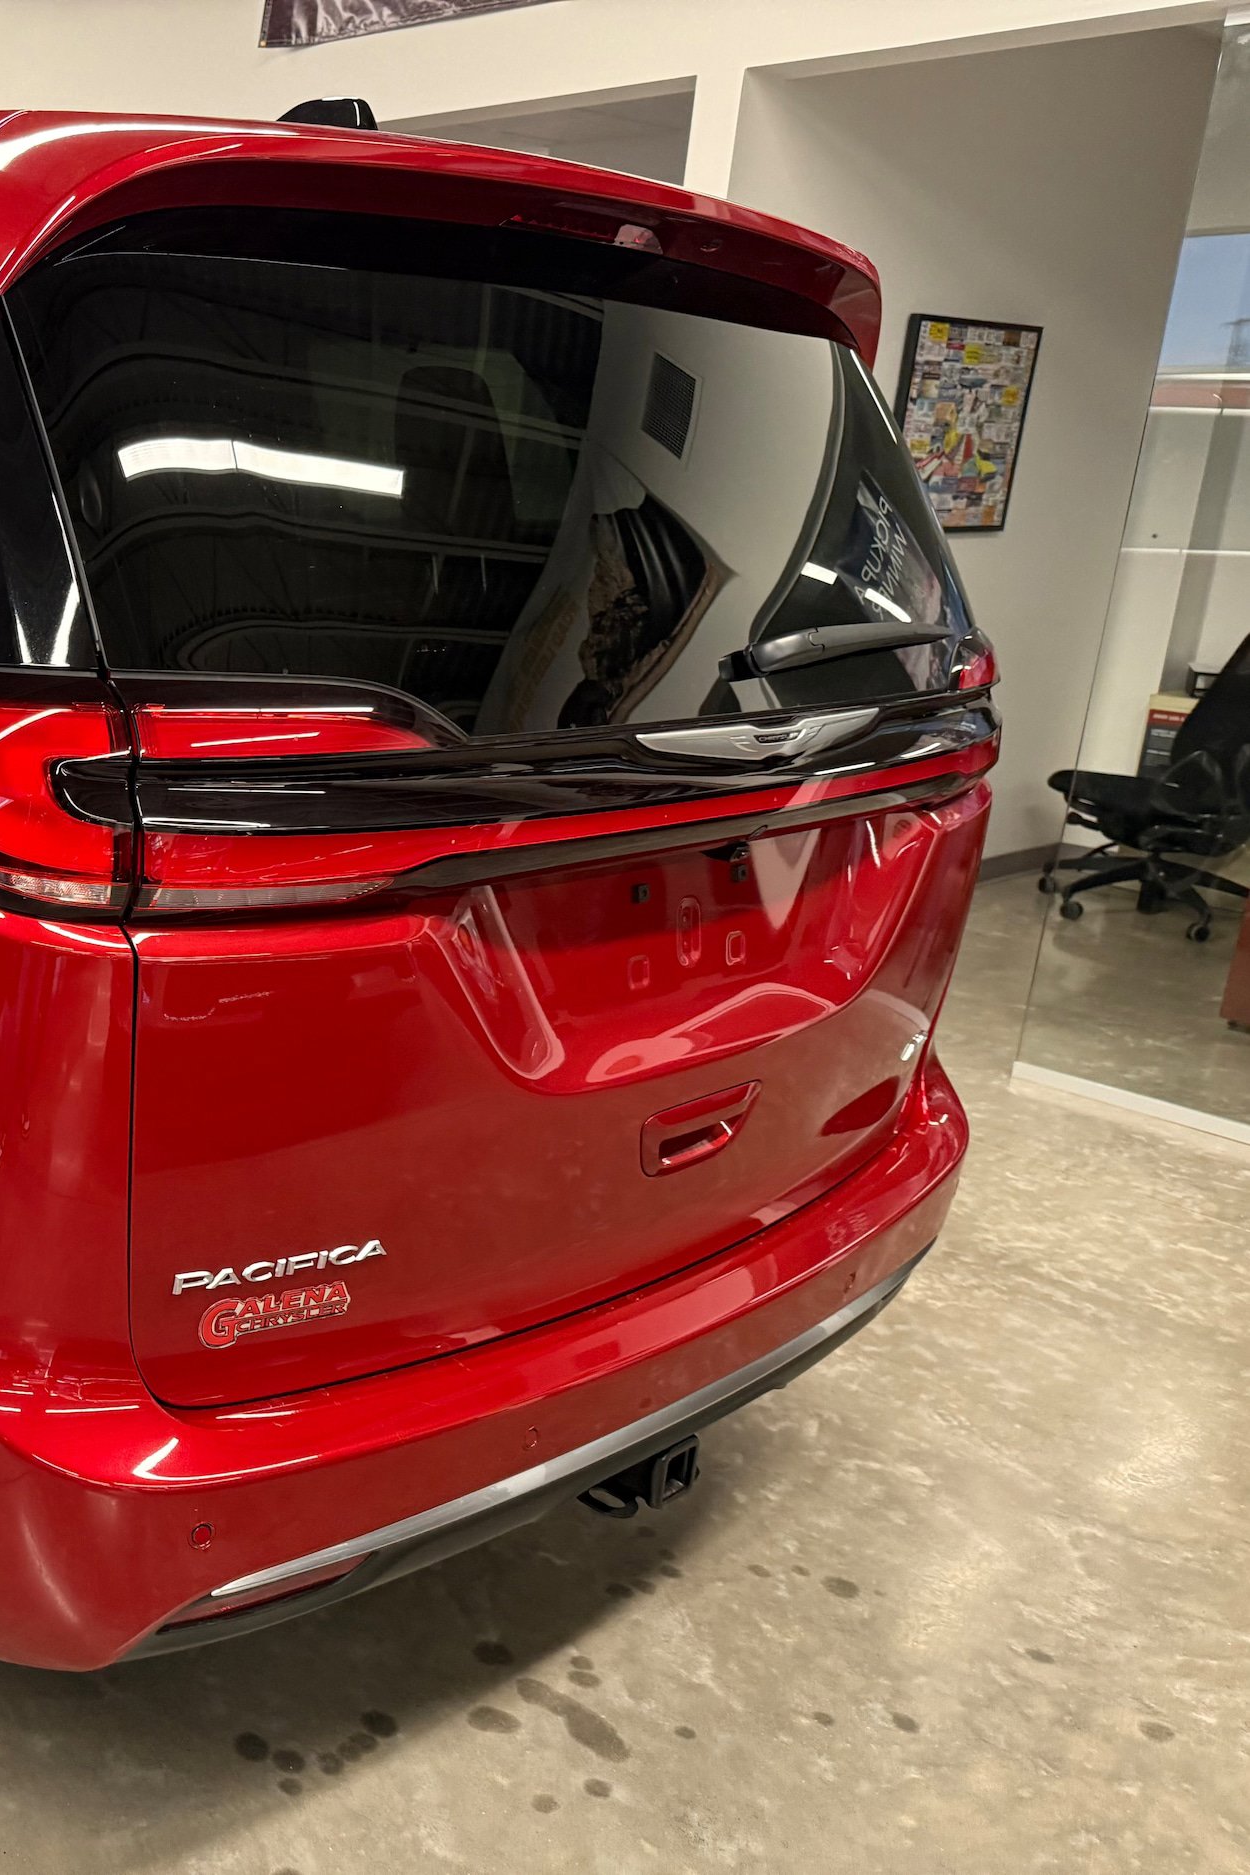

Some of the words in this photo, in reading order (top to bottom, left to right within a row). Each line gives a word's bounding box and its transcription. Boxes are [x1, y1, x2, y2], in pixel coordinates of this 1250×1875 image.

[172, 1239, 387, 1295] PACIFICA
[200, 1282, 348, 1347] GALENA
[236, 1302, 346, 1332] CHRYSLER
